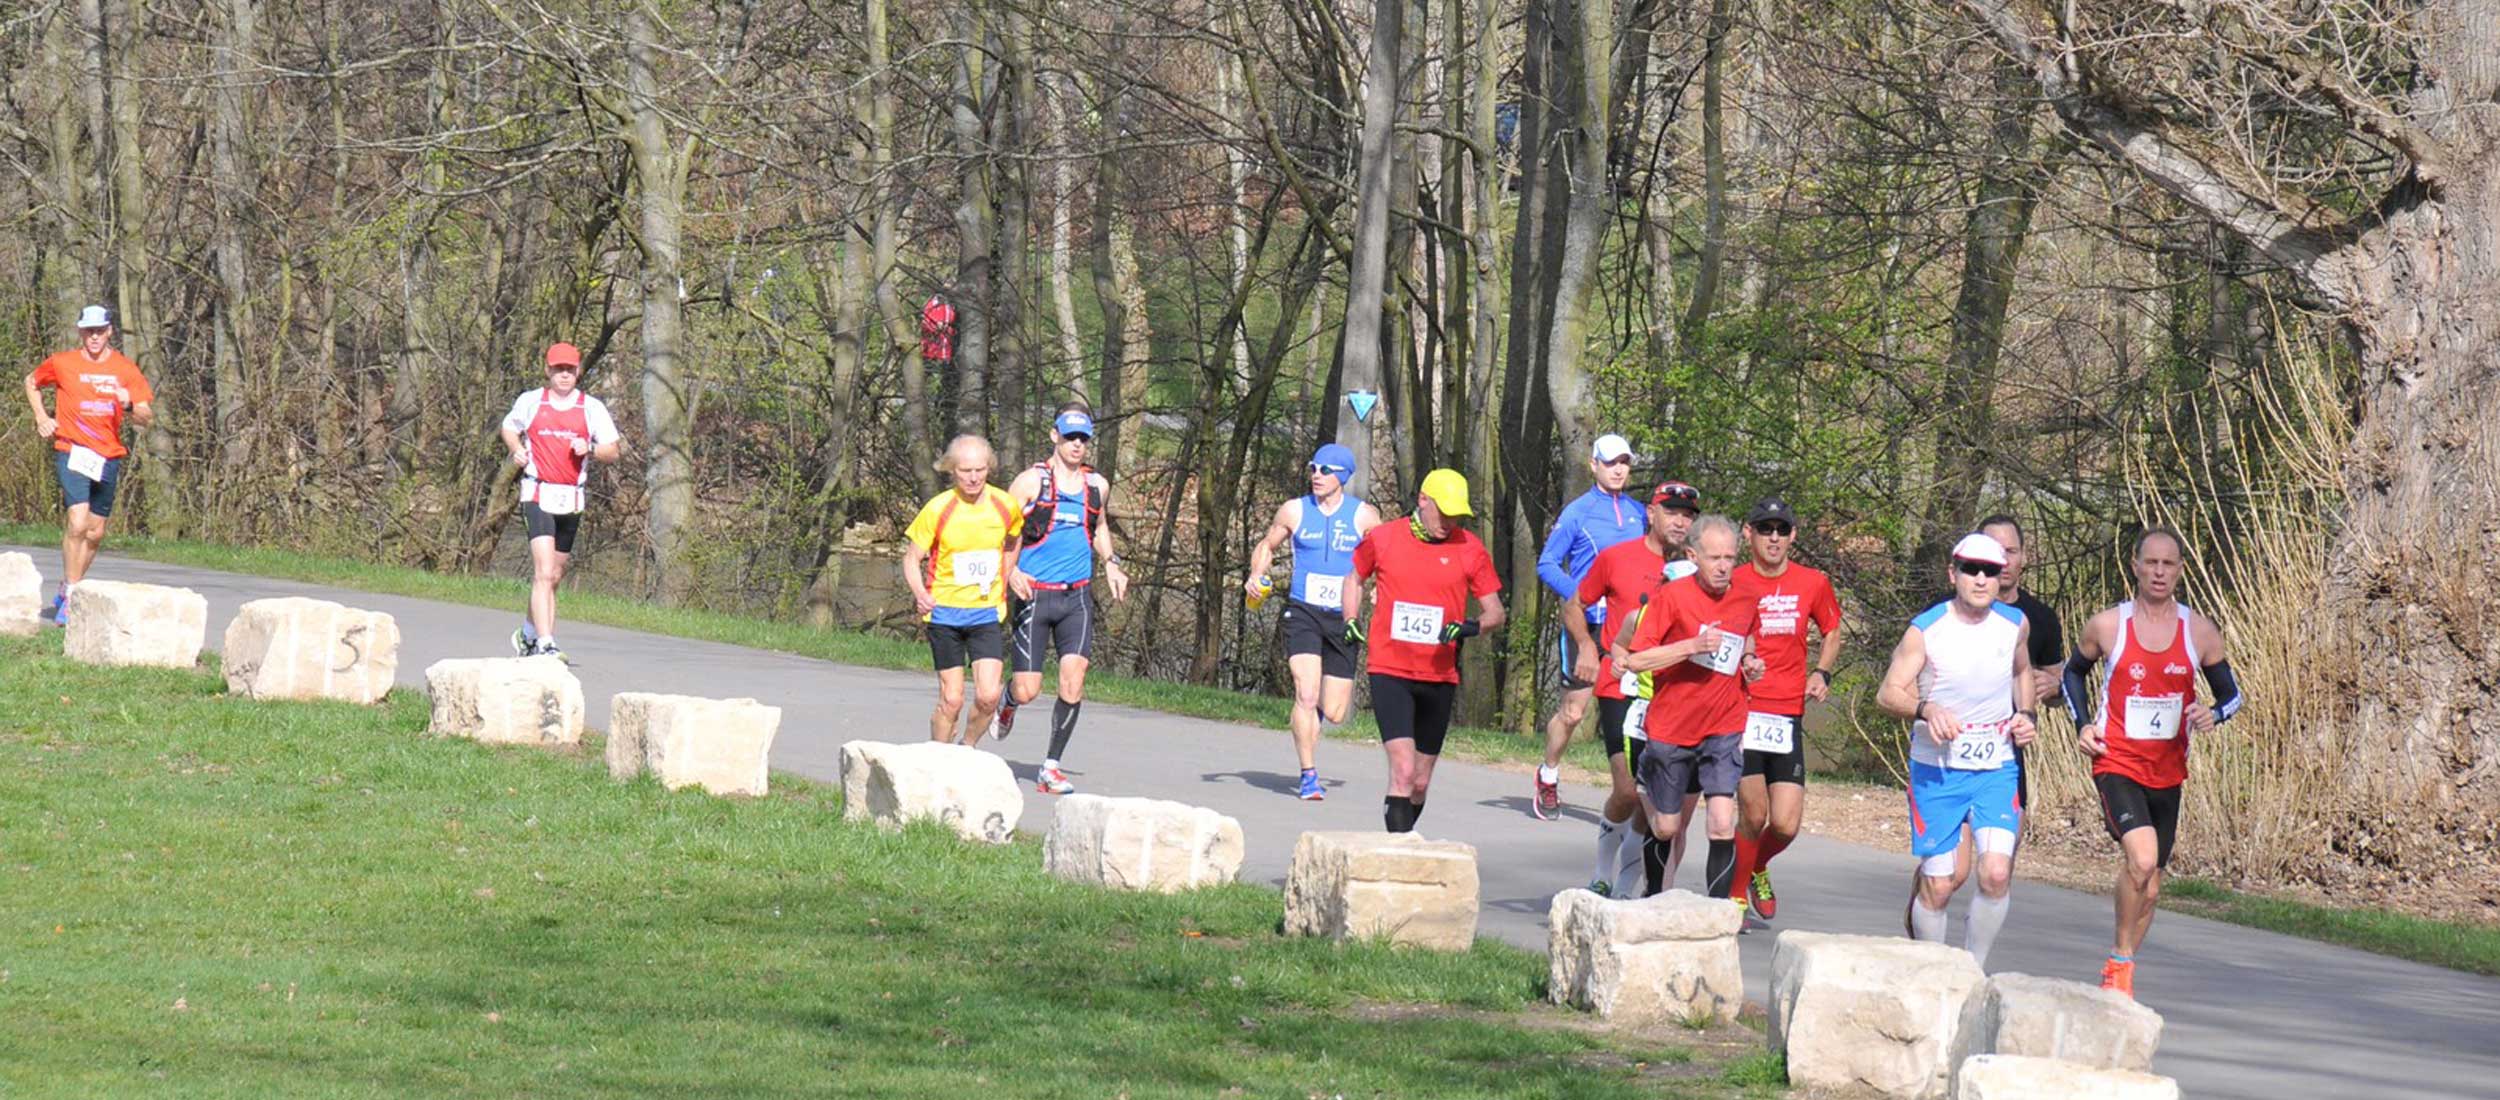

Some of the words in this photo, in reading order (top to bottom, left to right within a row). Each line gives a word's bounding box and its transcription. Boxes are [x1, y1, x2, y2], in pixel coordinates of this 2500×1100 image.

[1319, 585, 1337, 601] 26
[1400, 615, 1433, 635] 145
[2150, 711, 2162, 729] 4
[1752, 725, 1784, 744] 143
[1960, 741, 1995, 760] 249
